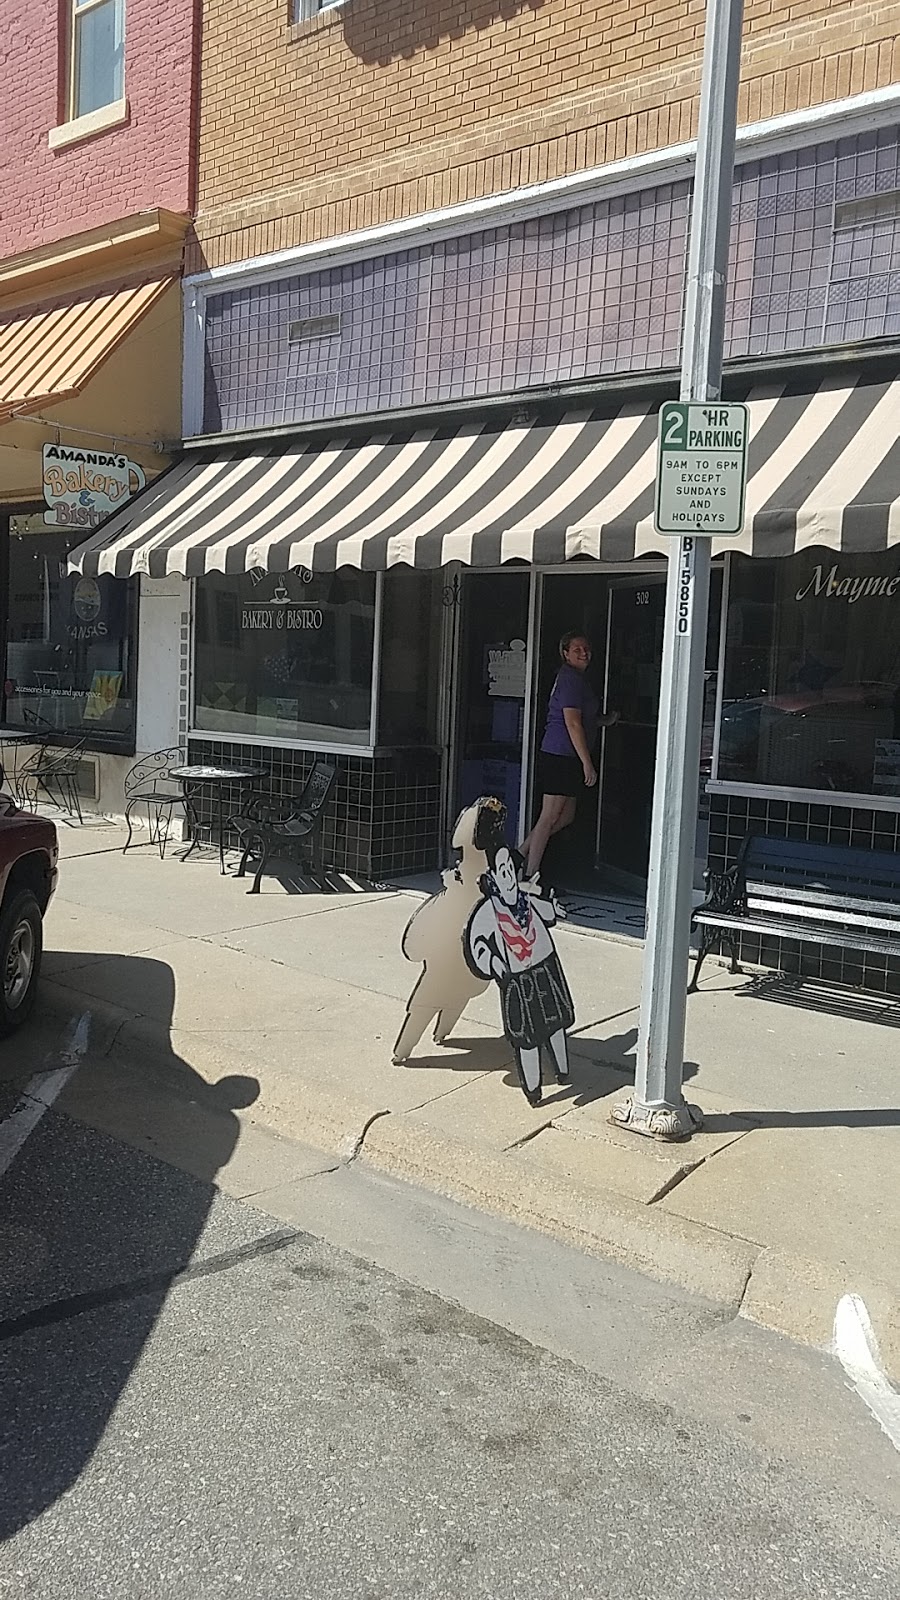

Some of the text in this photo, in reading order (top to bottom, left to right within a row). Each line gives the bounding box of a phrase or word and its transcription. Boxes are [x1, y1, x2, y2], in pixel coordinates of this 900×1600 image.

[664, 410, 729, 444] 2 HR
[688, 430, 742, 447] PARKING
[45, 446, 126, 469] AMANDA'S
[666, 460, 738, 470] 9AM TO 6PM
[44, 462, 129, 503] Bakery
[681, 473, 722, 483] EXCEPT
[78, 490, 96, 507] &
[675, 486, 727, 496] SUNDAYS
[689, 499, 711, 509] AND
[52, 501, 110, 527] Bistr
[672, 513, 726, 523] HOLIDAYS
[678, 536, 694, 633] B15850
[795, 564, 900, 604] Mayme
[635, 591, 650, 605] 302
[241, 609, 323, 629] BAKERY & BISTRO
[14, 684, 43, 694] accessories
[43, 683, 51, 695] for
[51, 688, 62, 699] you
[62, 685, 72, 697] and
[72, 689, 85, 701] your
[505, 957, 573, 1038] OPEN
